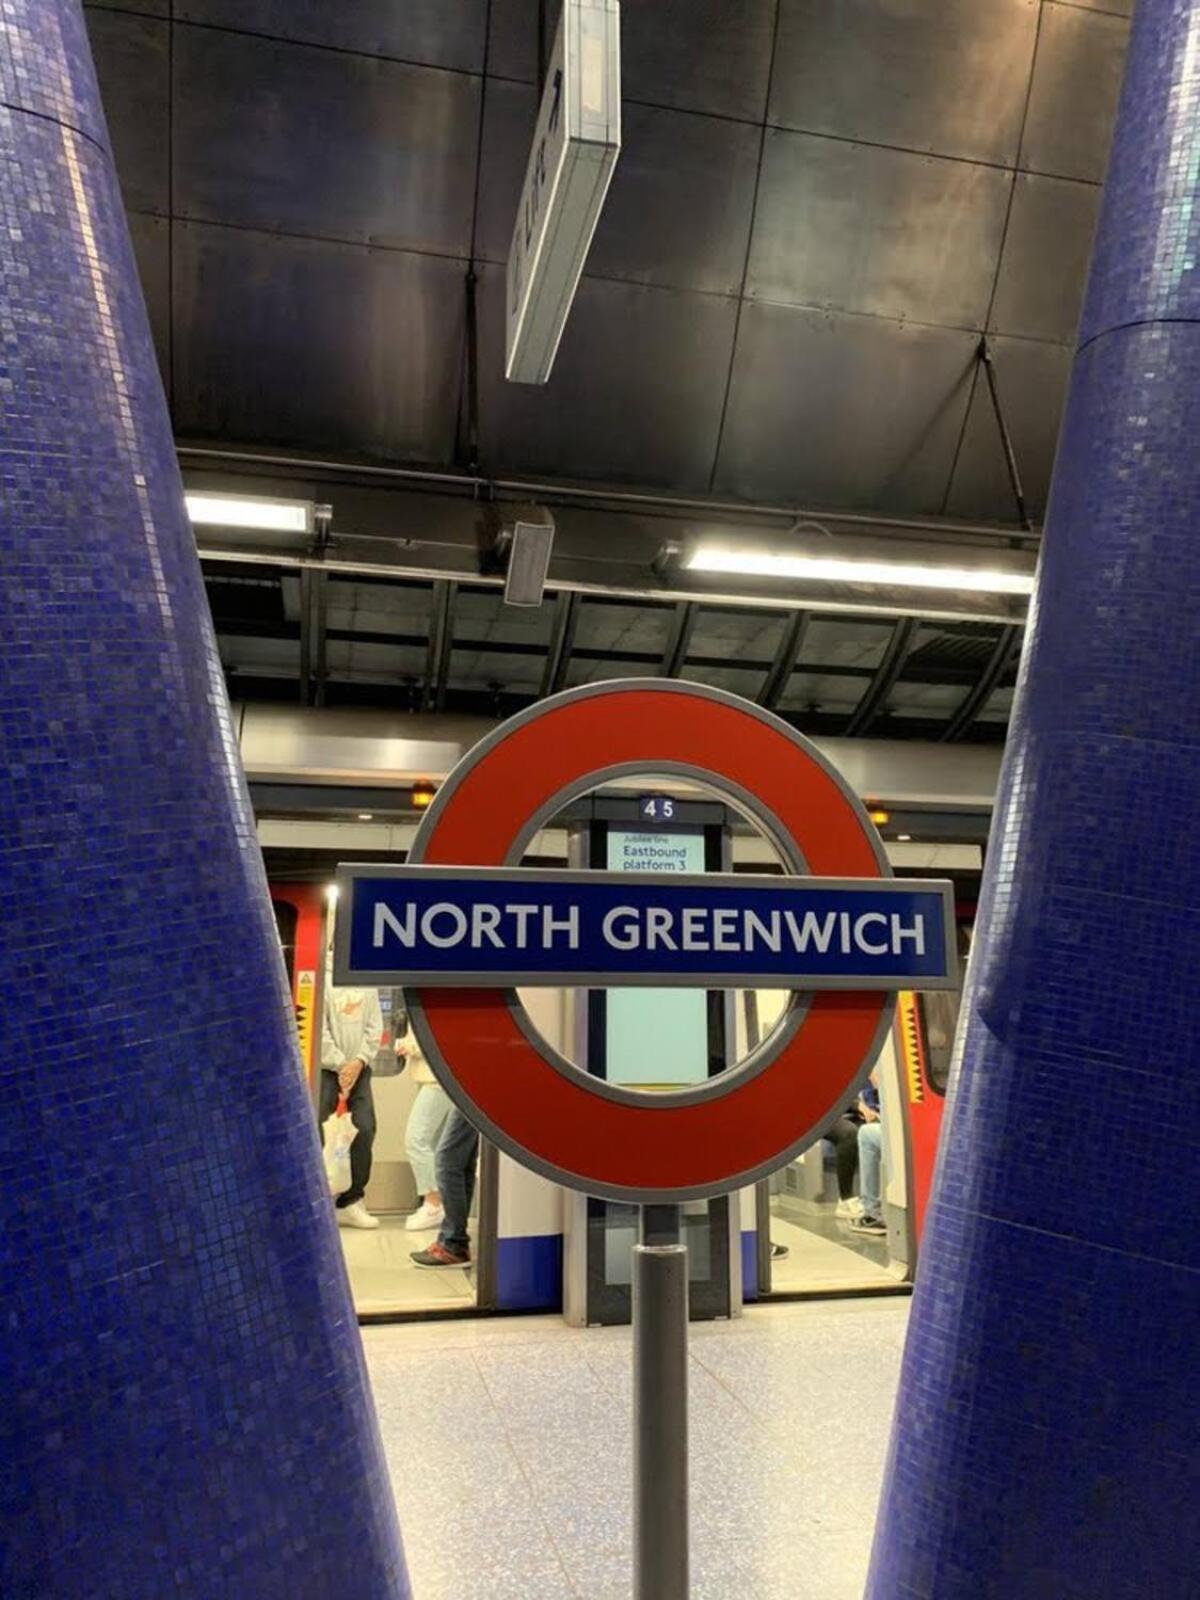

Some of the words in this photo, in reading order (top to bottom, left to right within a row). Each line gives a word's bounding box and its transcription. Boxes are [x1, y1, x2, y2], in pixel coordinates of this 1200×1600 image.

[644, 800, 656, 816] 4
[663, 801, 673, 817] 5
[624, 845, 686, 857] Eastbound
[624, 860, 675, 870] platform
[678, 860, 687, 870] 3
[373, 902, 580, 950] NORTH
[603, 906, 925, 956] GREENWICH
